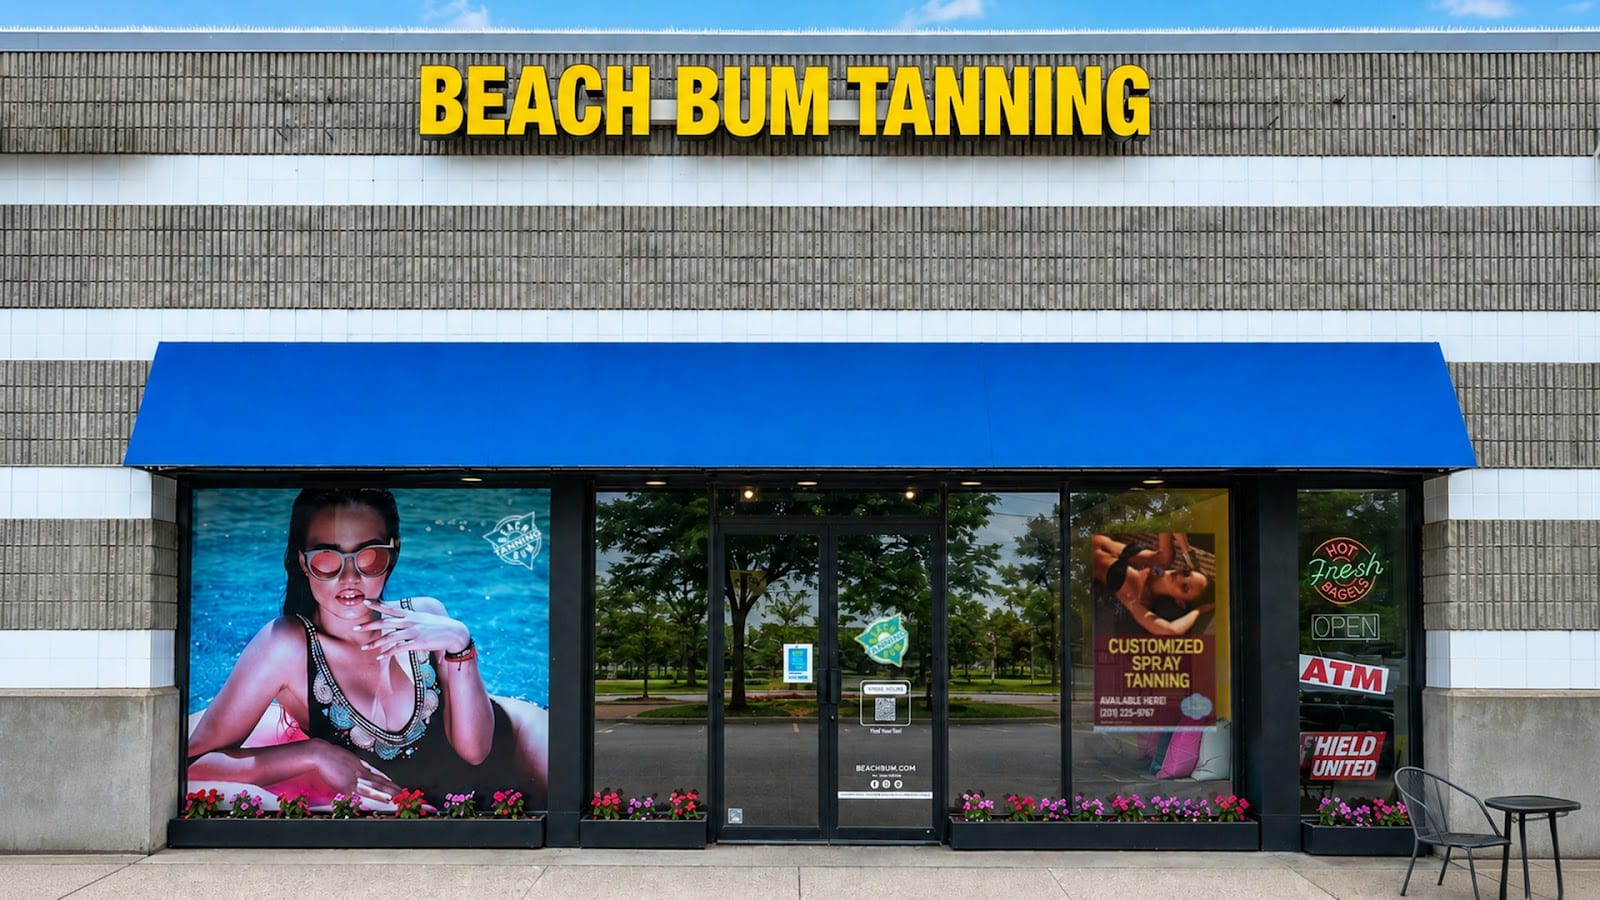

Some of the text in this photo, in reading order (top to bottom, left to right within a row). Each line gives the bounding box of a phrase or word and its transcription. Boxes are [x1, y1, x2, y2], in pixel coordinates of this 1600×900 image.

[419, 64, 1151, 137] BEACH BUM TANNING
[493, 529, 541, 556] TANNING
[1325, 542, 1358, 557] HOT
[1308, 553, 1384, 586] Fresh
[1321, 578, 1370, 600] BAGELS
[1314, 616, 1376, 637] OPEN
[1108, 638, 1204, 654] CUSTOMIZED
[1132, 655, 1182, 671] SPRAY
[1124, 672, 1190, 688] TANNING
[1300, 657, 1384, 692] ATM
[1100, 696, 1167, 705] AVAILABLE HERE!
[1100, 708, 1118, 718] (201)
[855, 764, 916, 772] BEACHBUM.COM
[1312, 759, 1377, 777] UNITED
